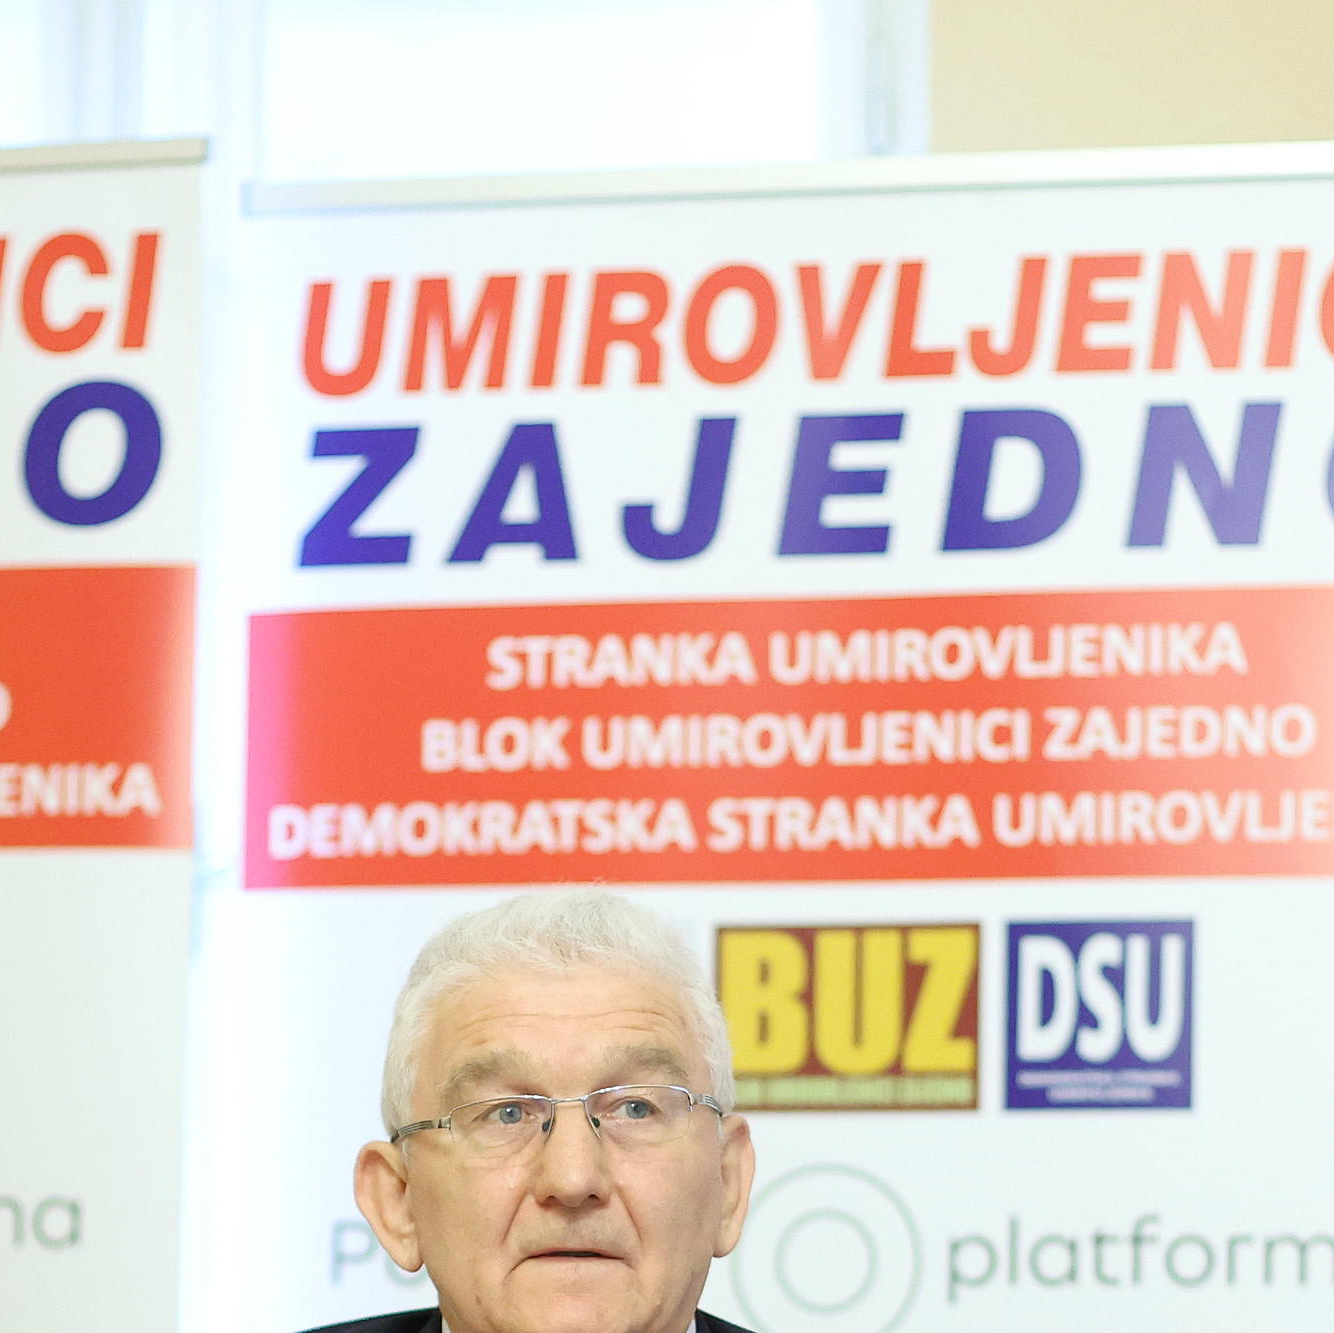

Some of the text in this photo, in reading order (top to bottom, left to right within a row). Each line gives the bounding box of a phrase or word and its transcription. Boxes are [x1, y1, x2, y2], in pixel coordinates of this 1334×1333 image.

[486, 621, 1246, 691] STRANKA UMIROVLJENIKA
[421, 702, 1316, 774] BLOK UMIROVLJENICI ZAJEDNO
[268, 798, 695, 861] DEMOKRATSKA
[706, 793, 980, 853] STRANKA
[720, 929, 977, 1074] BUZ
[1017, 932, 1186, 1063] DSU
